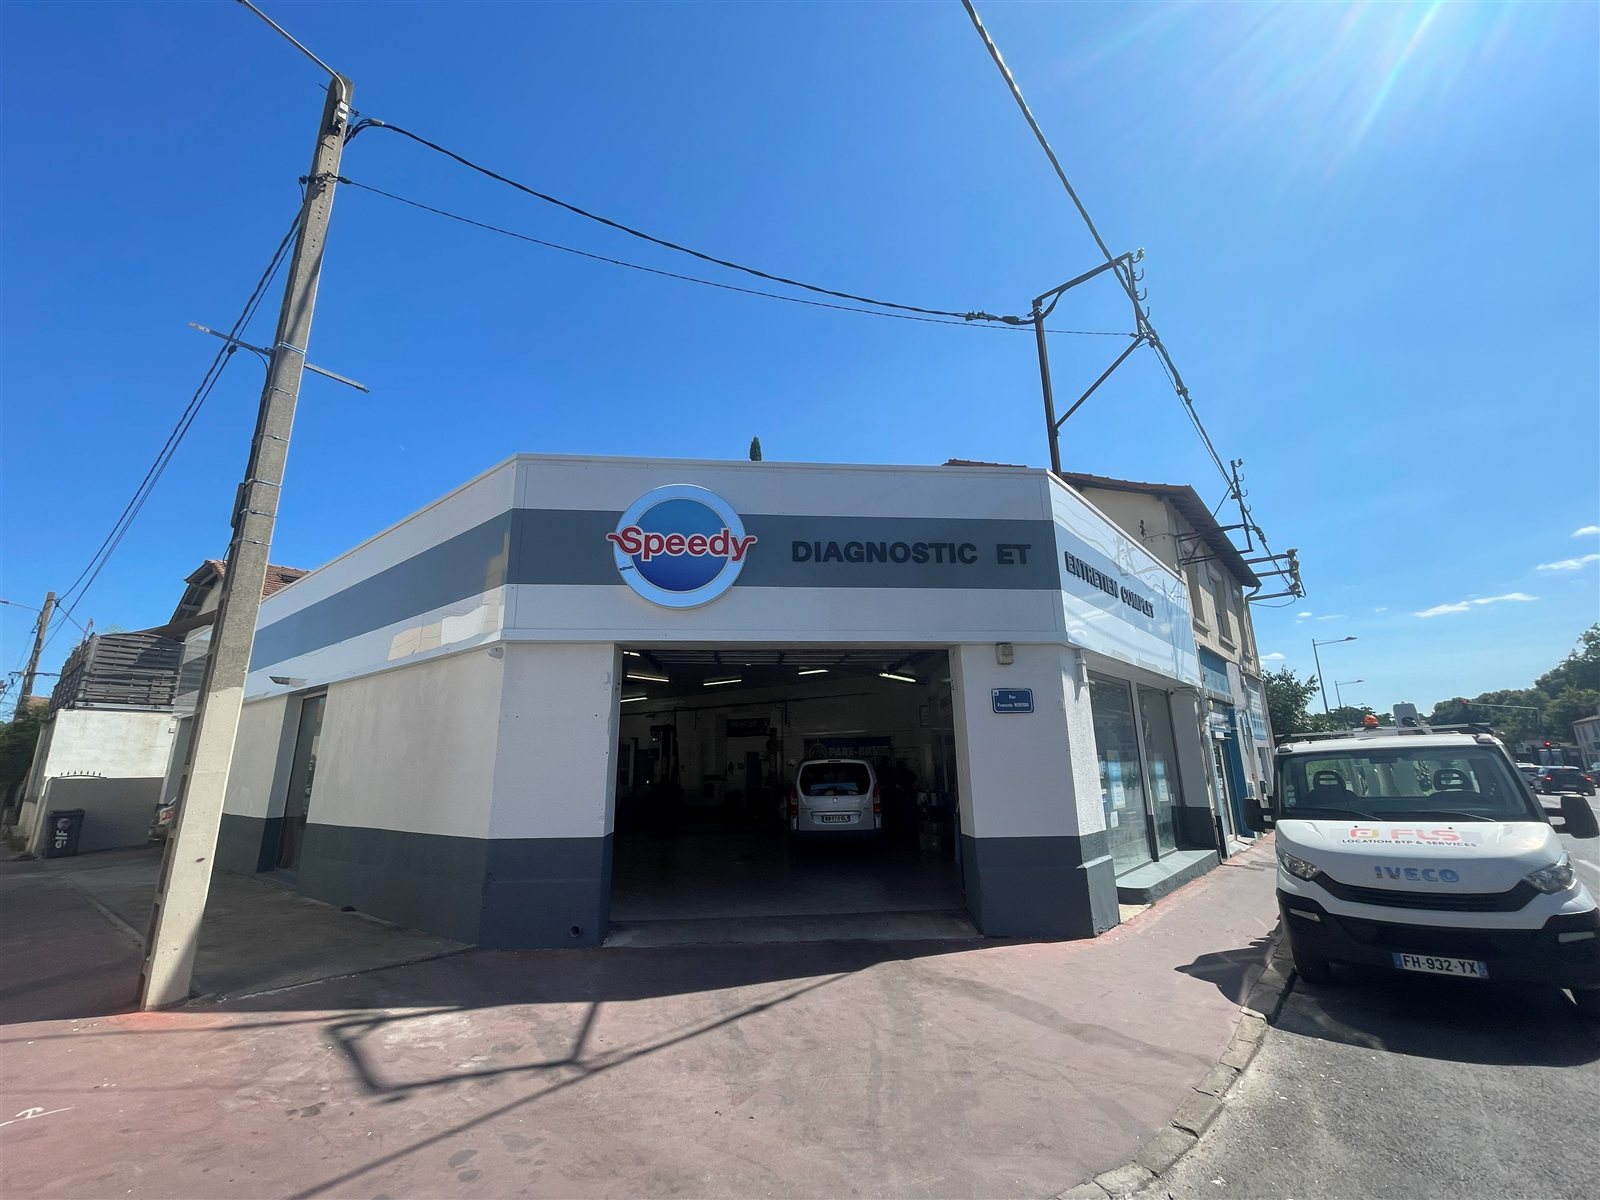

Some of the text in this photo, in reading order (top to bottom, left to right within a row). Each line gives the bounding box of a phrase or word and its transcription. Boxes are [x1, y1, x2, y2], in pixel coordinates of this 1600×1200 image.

[606, 525, 758, 563] Speedy
[791, 540, 1032, 565] DIAGNOSTIC ET
[1064, 550, 1154, 619] ENTRETIEN COMPLET
[1390, 828, 1460, 842] FLS
[1374, 865, 1460, 883] IVECO
[1402, 954, 1478, 975] FH-932-YX
